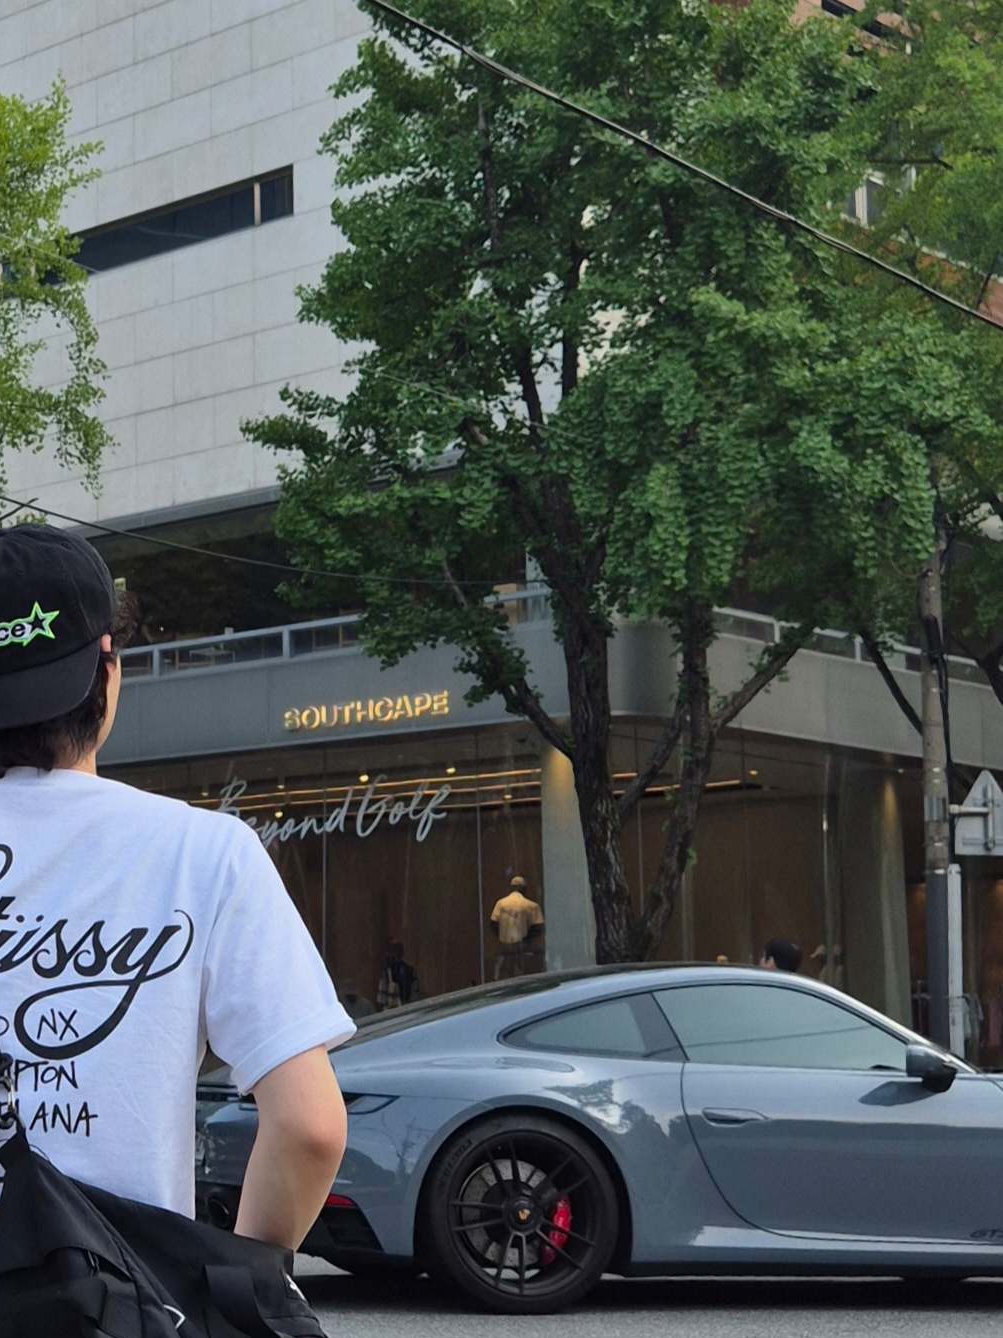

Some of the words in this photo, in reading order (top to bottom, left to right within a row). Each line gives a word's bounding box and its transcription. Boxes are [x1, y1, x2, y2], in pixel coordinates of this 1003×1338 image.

[284, 689, 450, 731] SOUTHCAPE
[355, 774, 452, 842] Golf
[29, 1101, 99, 1137] ANA
